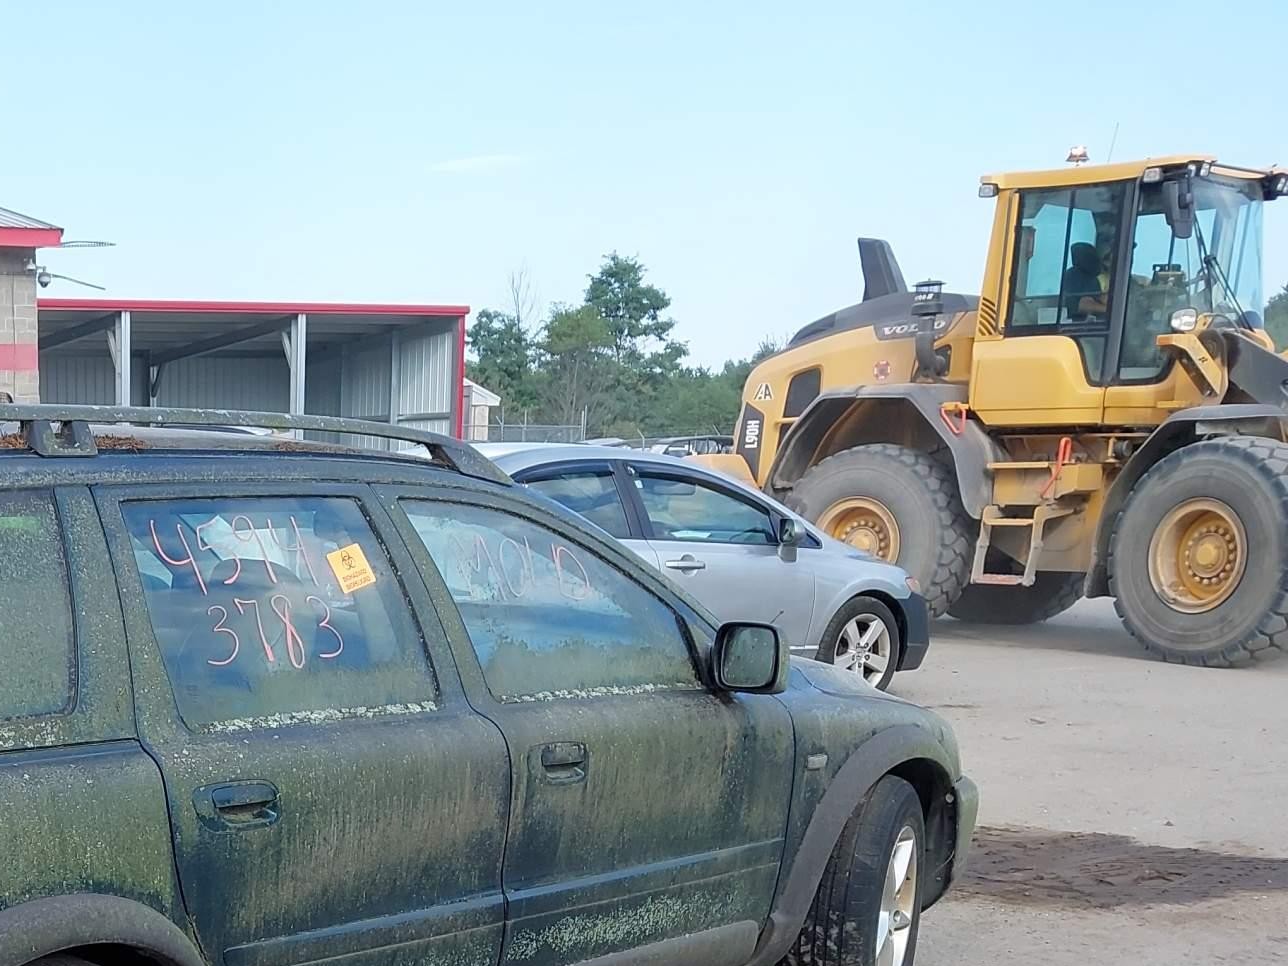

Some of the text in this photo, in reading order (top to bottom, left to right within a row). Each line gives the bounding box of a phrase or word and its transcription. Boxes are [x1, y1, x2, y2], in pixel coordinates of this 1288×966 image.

[883, 321, 947, 336] VOLO
[744, 420, 760, 449] L90H
[150, 515, 319, 596] 4594
[207, 594, 344, 669] 3783
